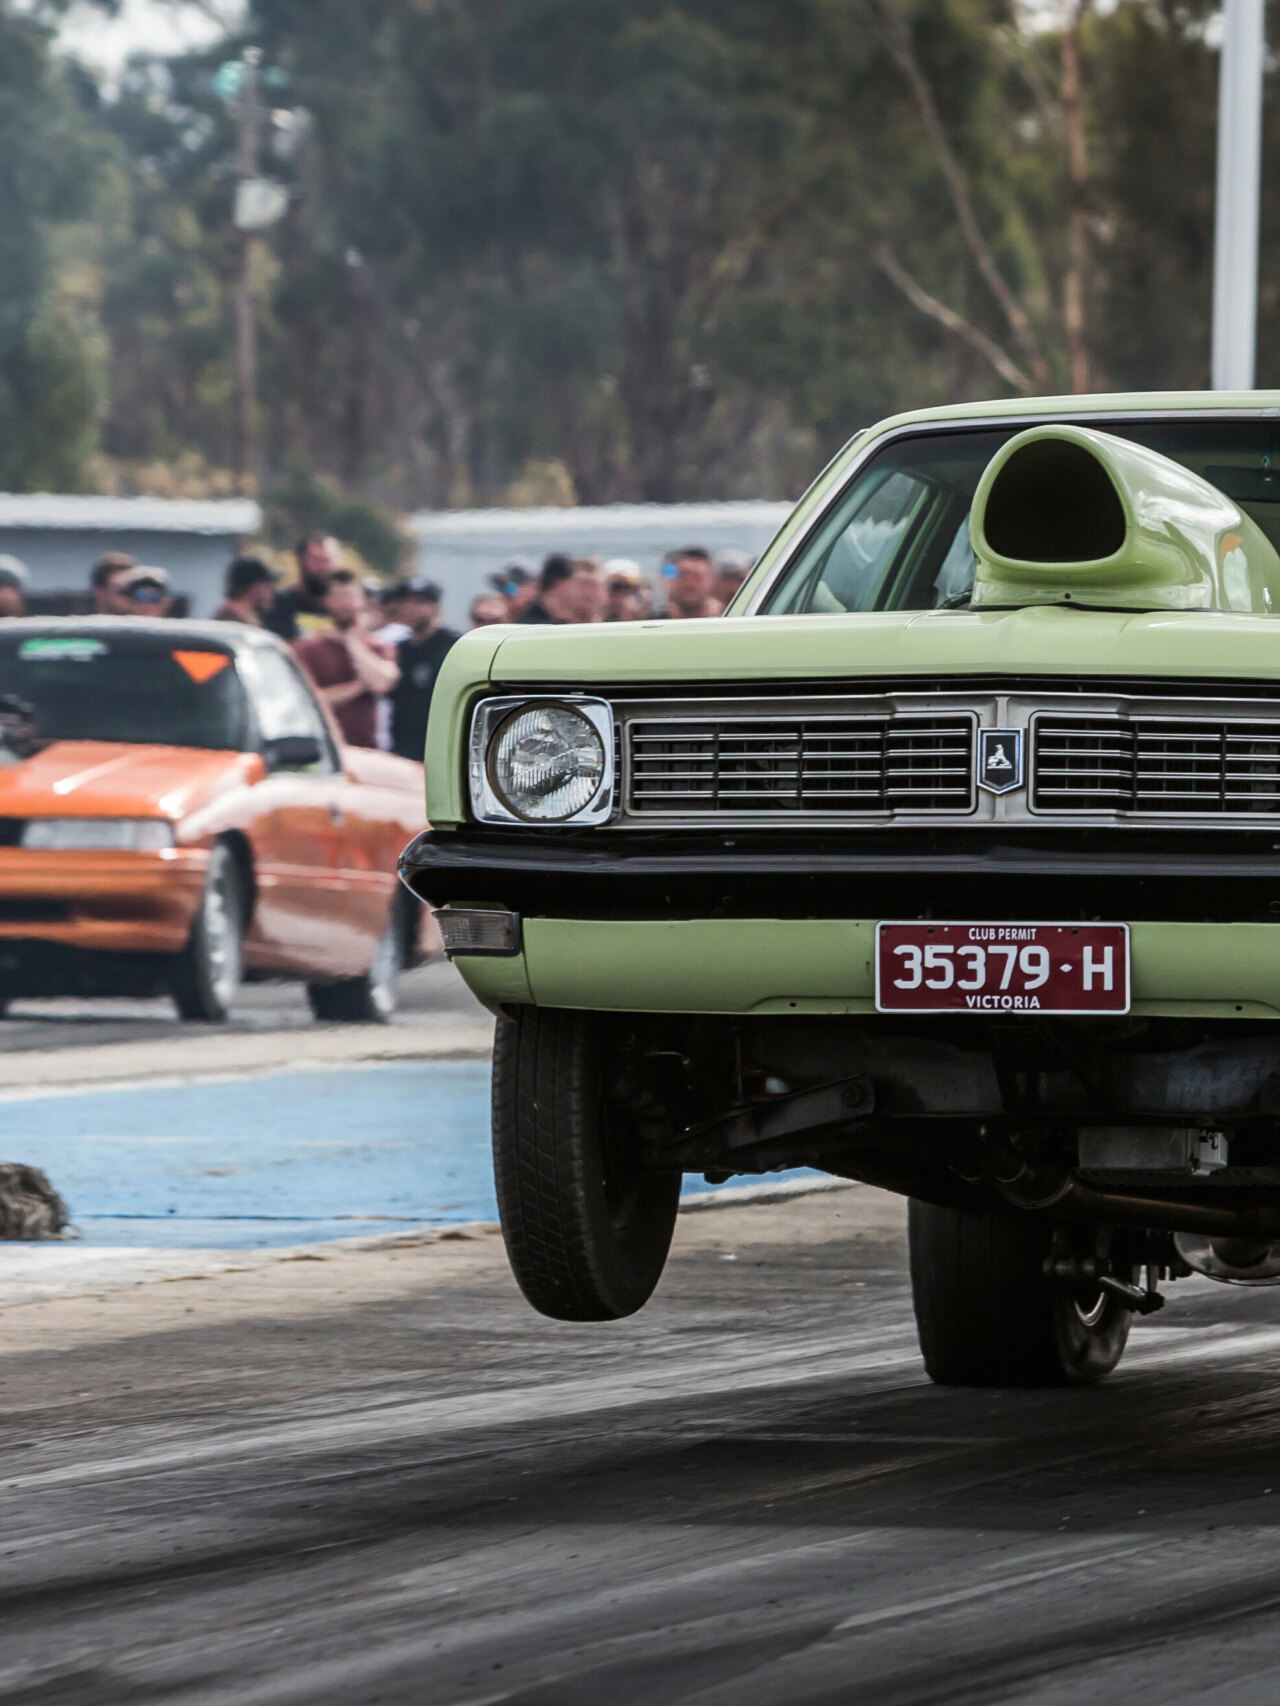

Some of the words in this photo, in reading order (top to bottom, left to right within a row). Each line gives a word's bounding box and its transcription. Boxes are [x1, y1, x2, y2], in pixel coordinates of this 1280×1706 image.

[968, 928, 996, 940] CLUB
[998, 928, 1037, 940] PERMIT
[965, 995, 1041, 1009] VICTORIA
